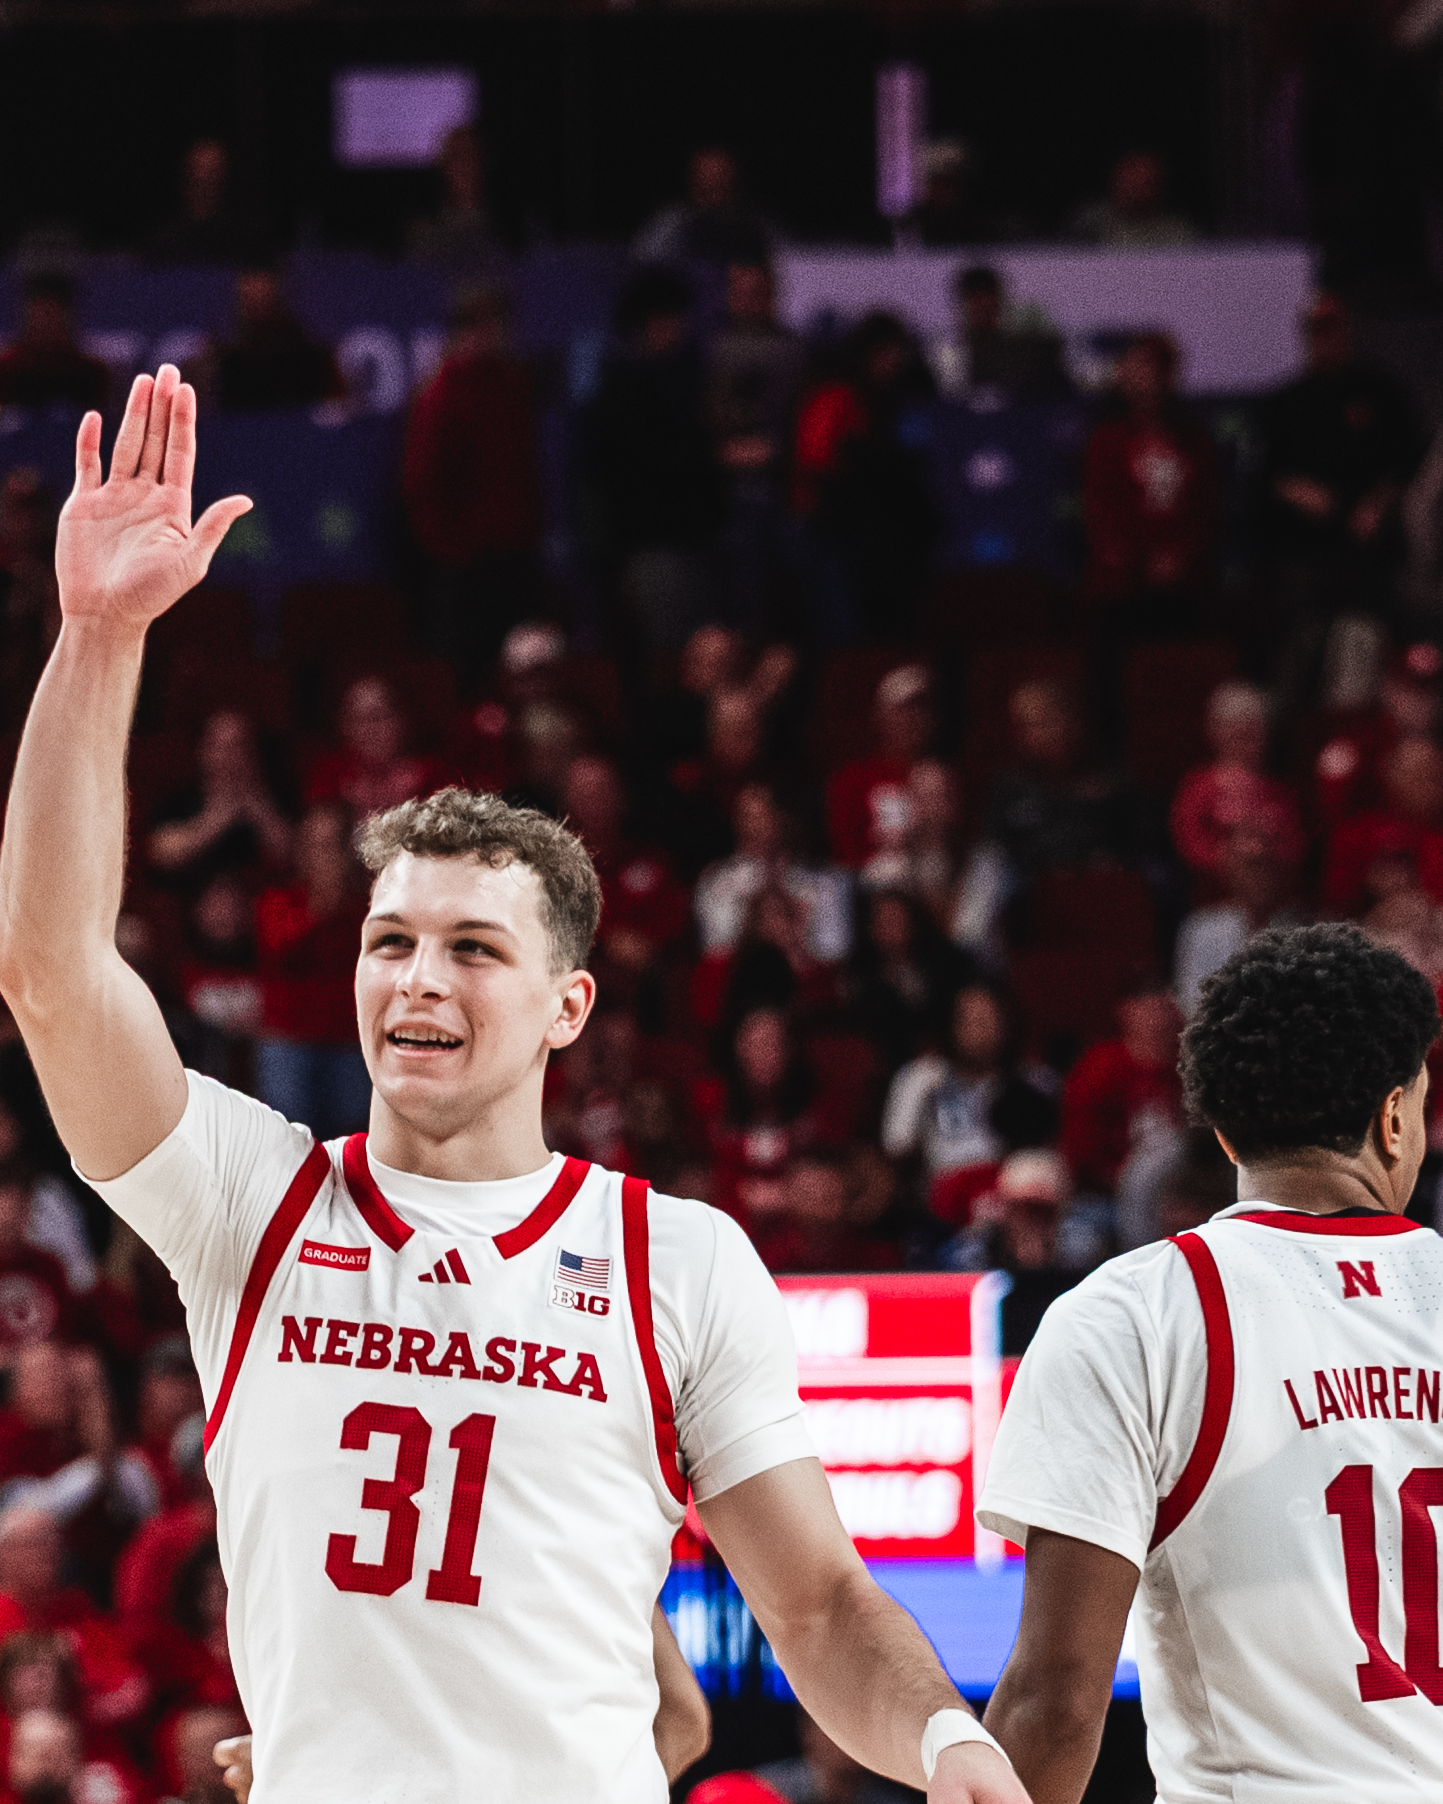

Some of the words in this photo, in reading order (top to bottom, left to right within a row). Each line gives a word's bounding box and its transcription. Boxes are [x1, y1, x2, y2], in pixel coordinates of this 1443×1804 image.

[303, 1246, 369, 1267] GRADUATE
[1335, 1260, 1383, 1299] N
[277, 1315, 608, 1404] NEBRASKA
[1283, 1366, 1443, 1431] LAWREN
[324, 1400, 497, 1608] 31
